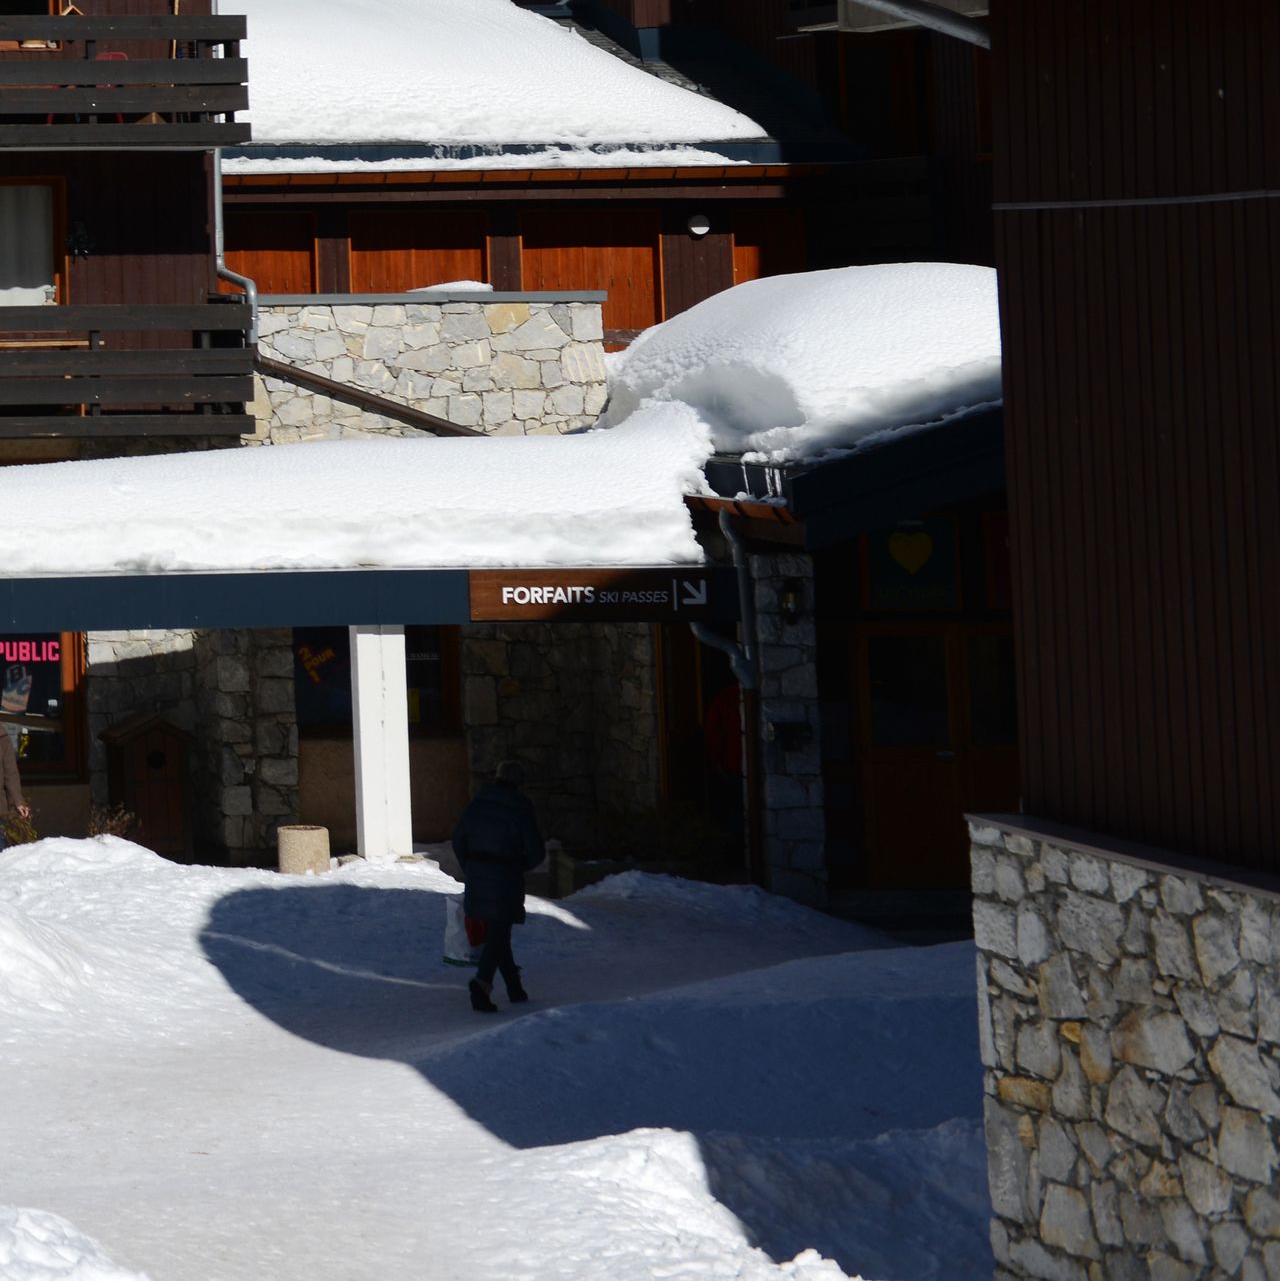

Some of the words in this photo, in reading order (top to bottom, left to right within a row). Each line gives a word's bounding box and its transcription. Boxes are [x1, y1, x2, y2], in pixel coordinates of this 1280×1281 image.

[501, 586, 596, 606] FORFAITS
[598, 590, 619, 605] SKI
[621, 589, 669, 605] PASSES
